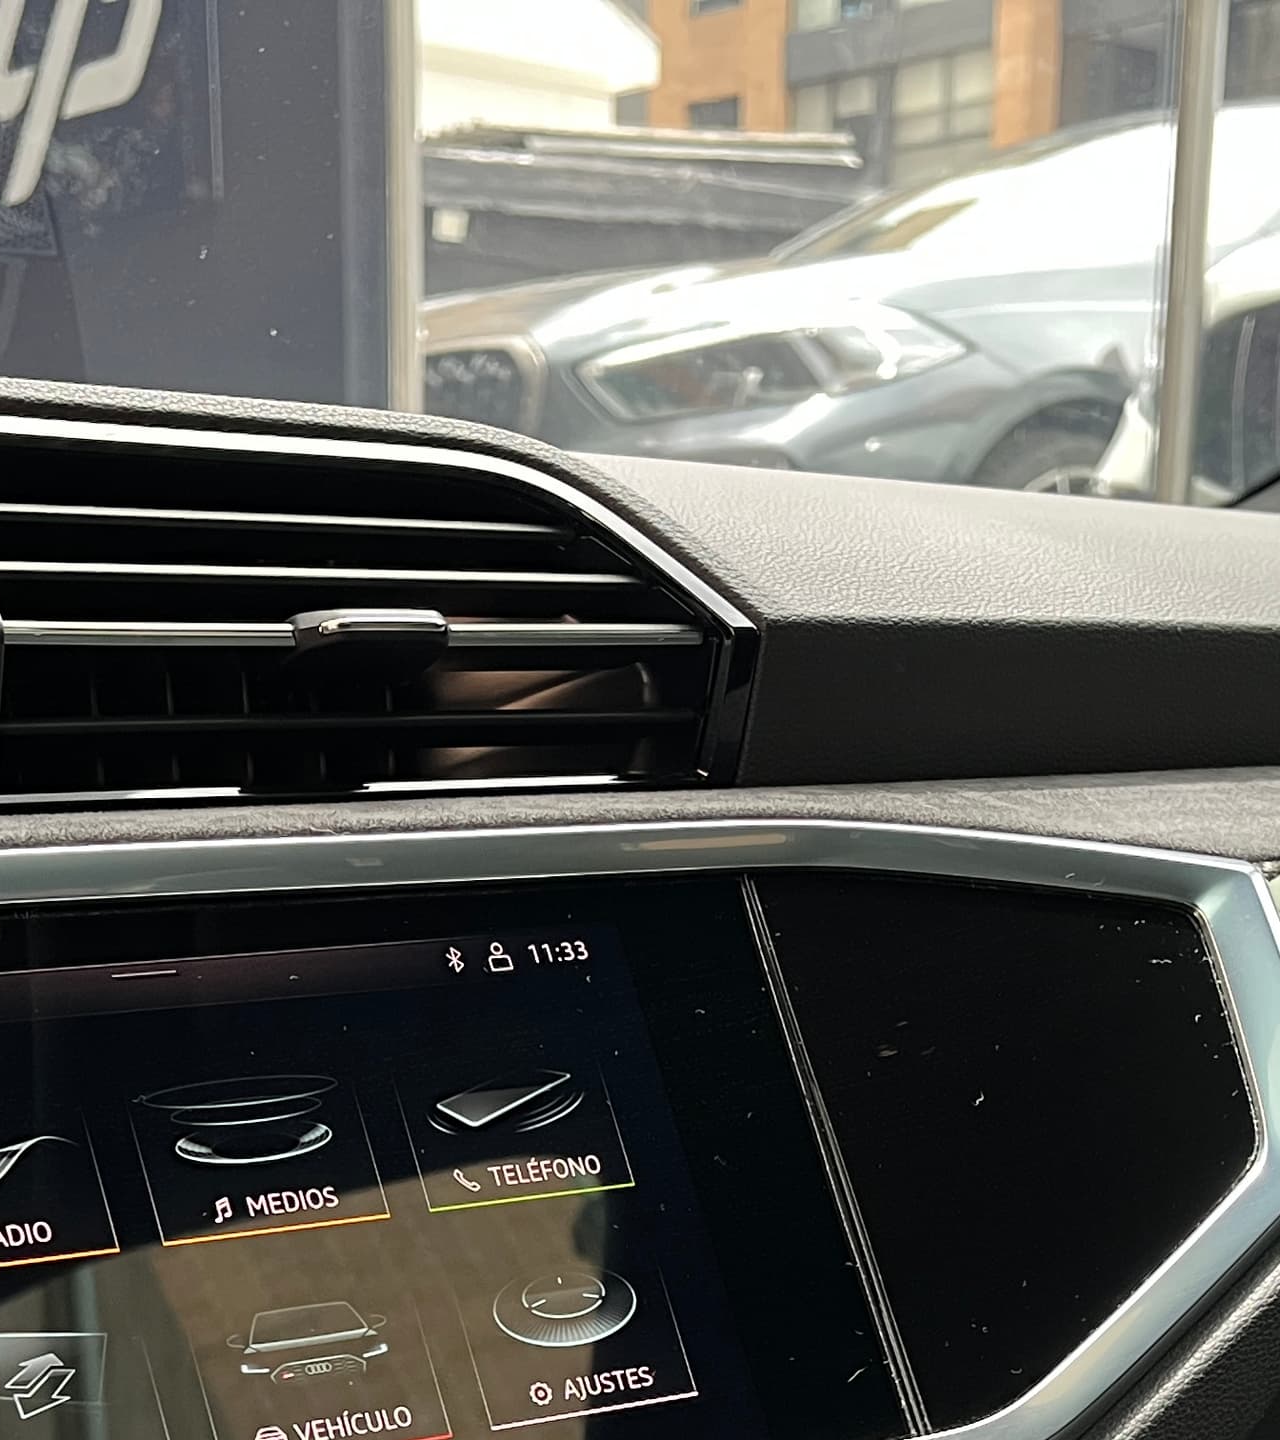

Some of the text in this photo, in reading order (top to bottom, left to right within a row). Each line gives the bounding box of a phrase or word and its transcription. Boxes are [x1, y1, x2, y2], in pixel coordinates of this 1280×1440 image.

[528, 940, 590, 965] 11:33
[487, 1154, 602, 1188] TELÉFONO
[246, 1186, 340, 1218] MEDIOS
[563, 1366, 654, 1401] AJUSTES
